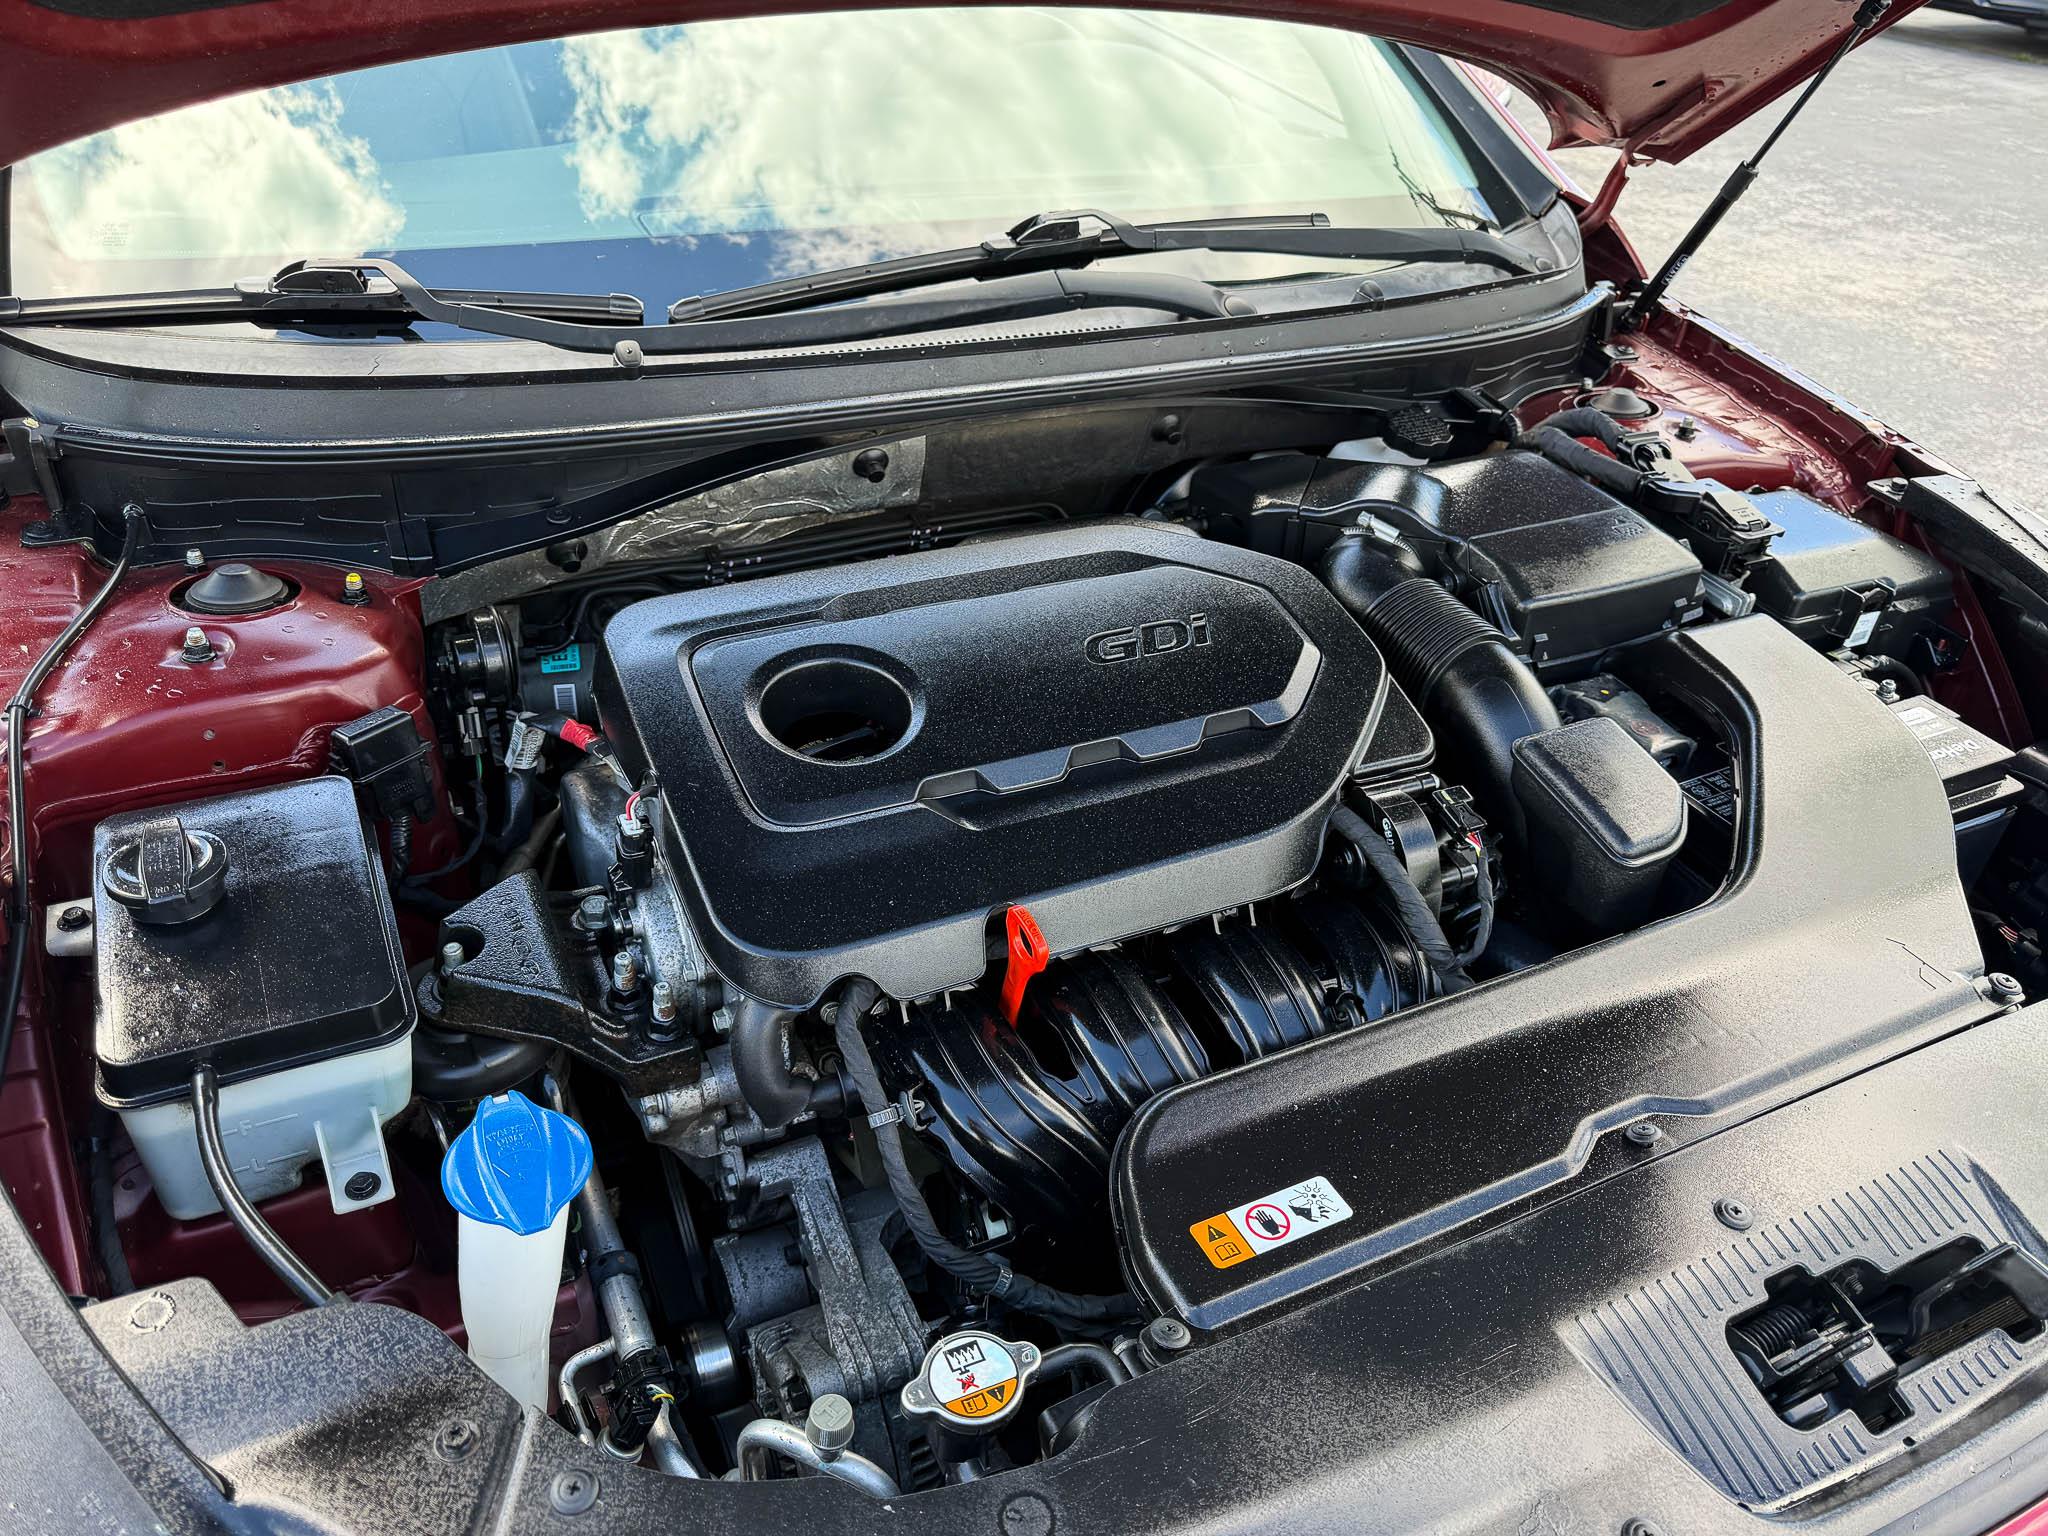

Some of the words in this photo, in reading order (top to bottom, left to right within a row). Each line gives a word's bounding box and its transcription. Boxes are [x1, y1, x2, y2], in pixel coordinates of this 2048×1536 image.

[1084, 612, 1212, 665] GDi
[1017, 909, 1033, 926] ENG
[1030, 926, 1043, 943] OIL
[239, 1119, 253, 1137] F
[814, 1396, 848, 1428] H
